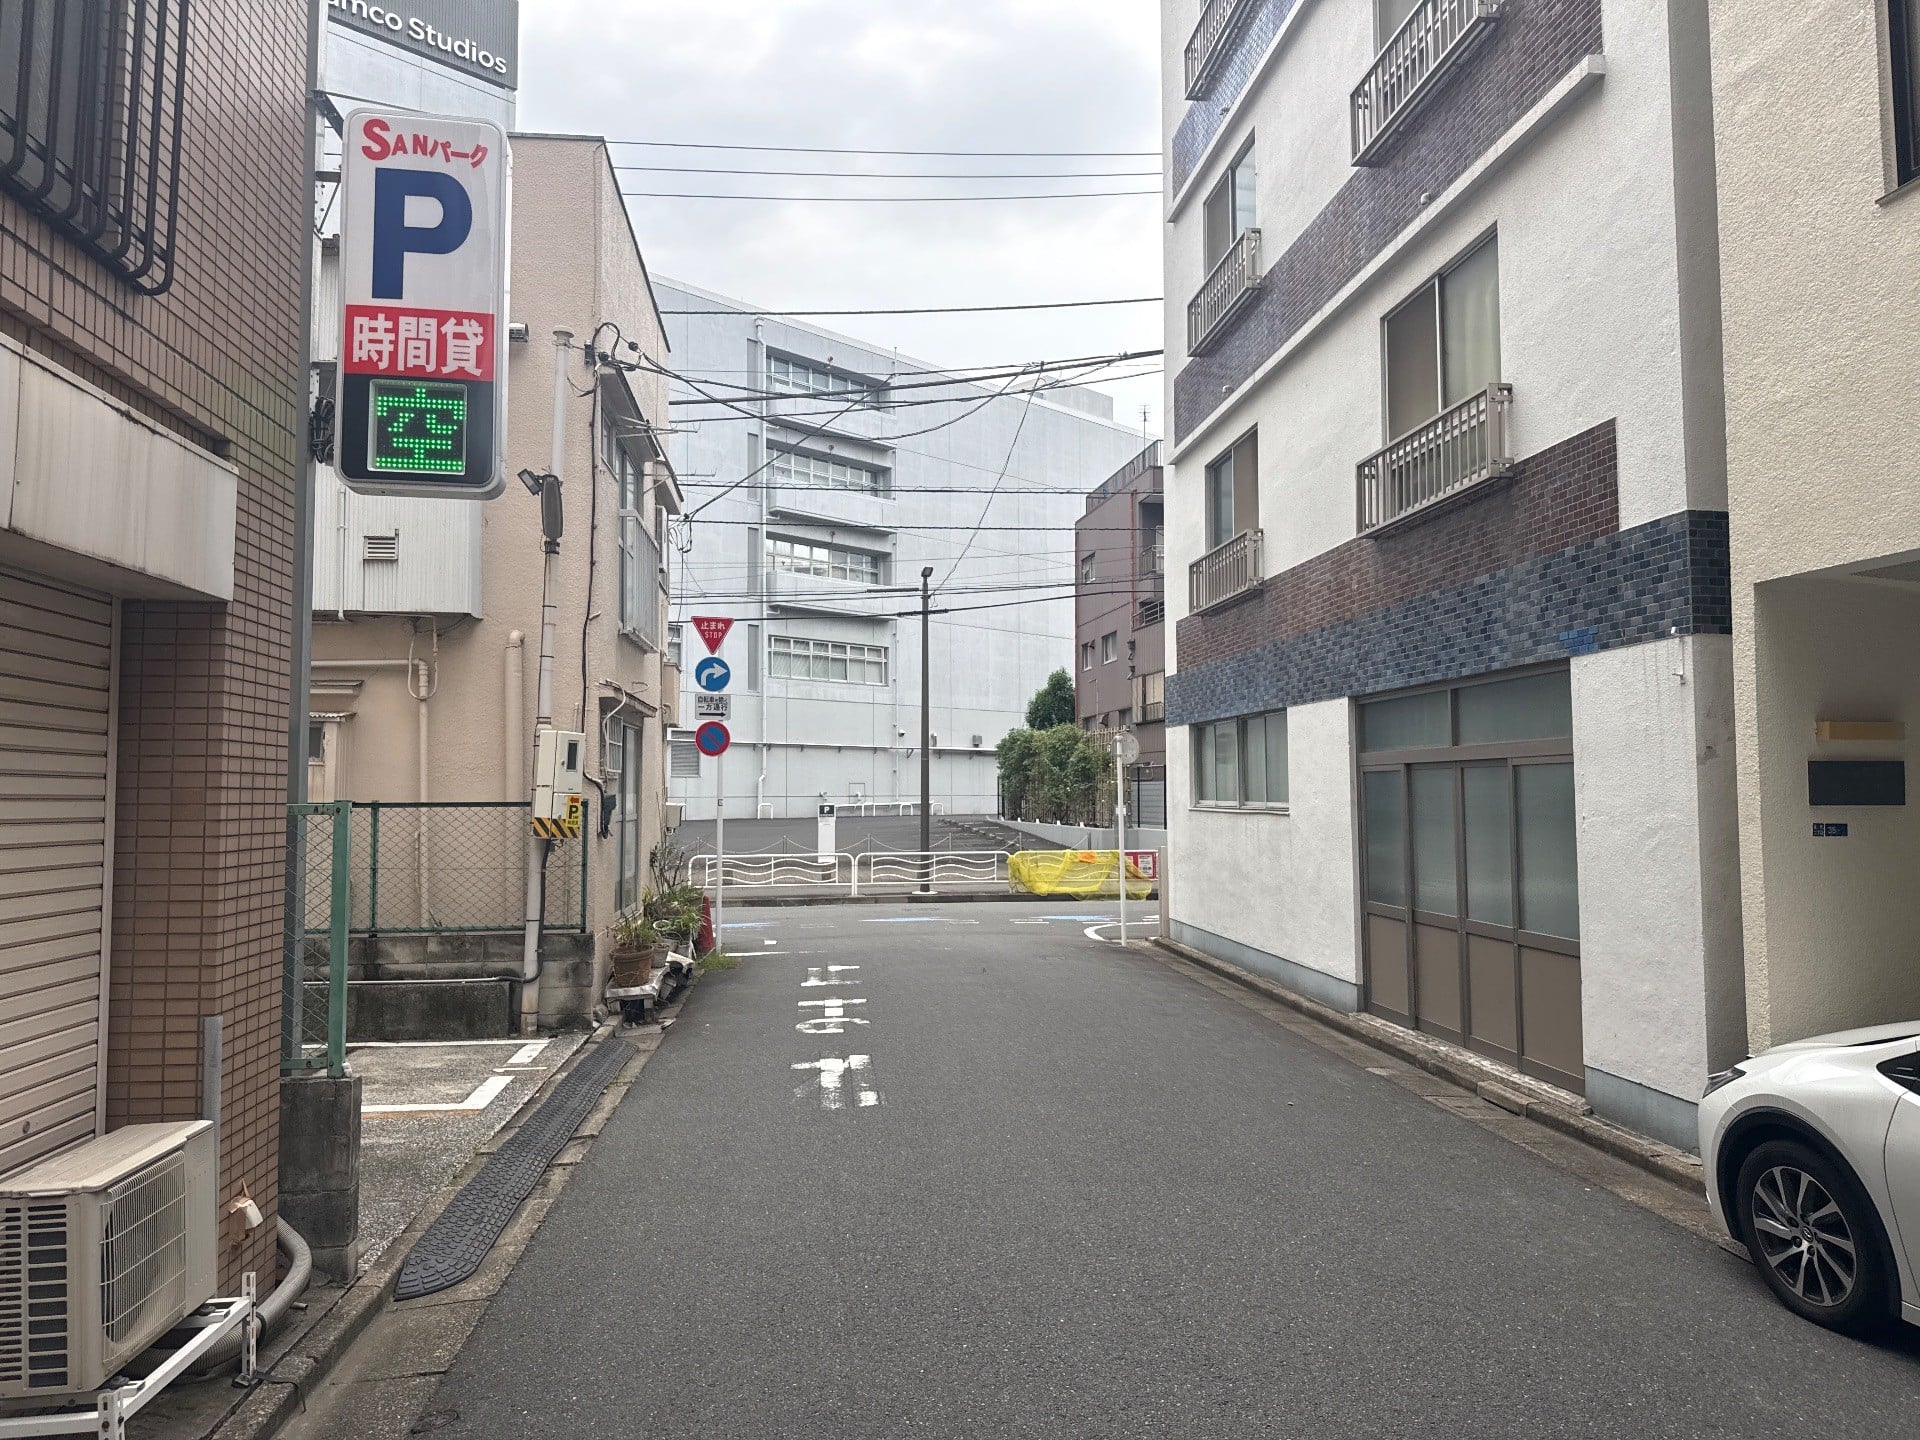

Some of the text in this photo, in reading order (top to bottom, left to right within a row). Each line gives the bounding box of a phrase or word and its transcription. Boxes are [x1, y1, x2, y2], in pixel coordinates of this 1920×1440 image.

[407, 17, 507, 74] Studios
[361, 118, 489, 169] SANパーク
[372, 167, 473, 299] P
[352, 315, 485, 378] 時間貸
[374, 388, 465, 472] 空
[700, 621, 726, 630] 止まれ
[704, 631, 722, 639] STOP
[697, 703, 728, 711] 一方通行
[568, 804, 579, 819] P
[824, 806, 830, 814] P
